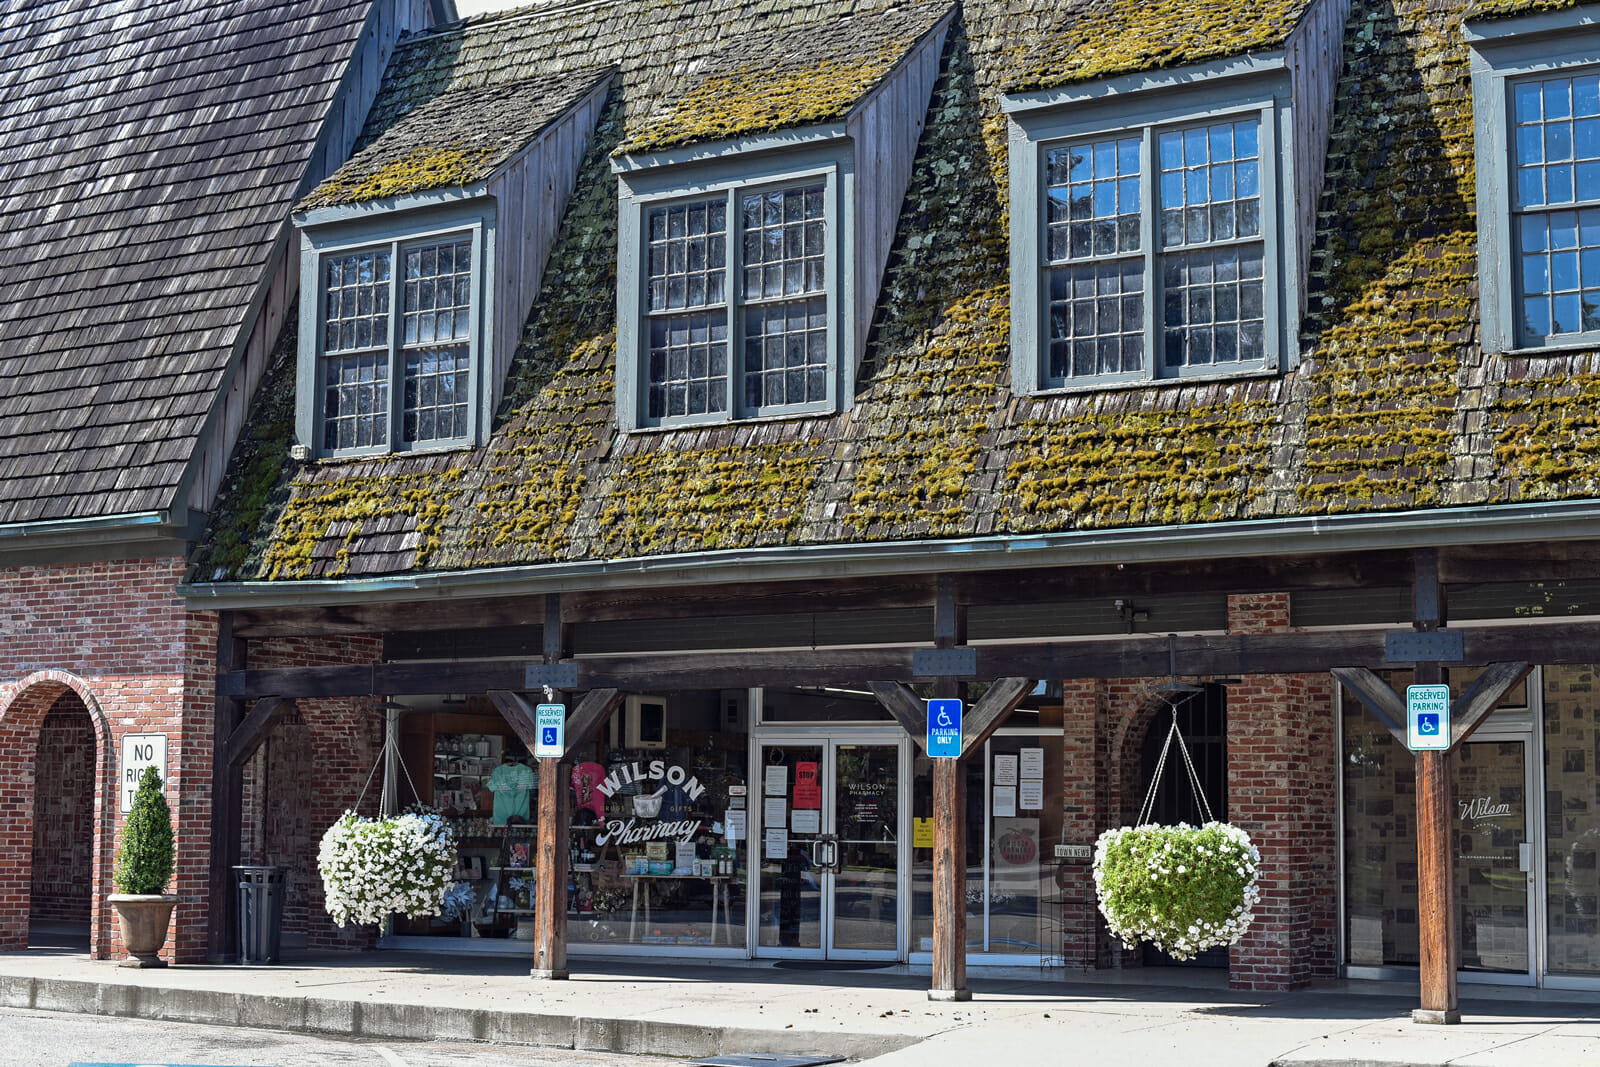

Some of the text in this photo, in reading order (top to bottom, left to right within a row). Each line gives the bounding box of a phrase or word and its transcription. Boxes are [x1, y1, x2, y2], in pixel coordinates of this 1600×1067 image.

[1411, 692, 1445, 700] RESERVED
[1412, 702, 1444, 710] PARKING
[538, 709, 562, 717] RESERVED
[539, 718, 561, 726] PARKING
[931, 728, 959, 736] PARKING
[135, 744, 153, 761] NO
[798, 771, 815, 779] STOP
[596, 760, 706, 801] WILSON
[1459, 796, 1511, 820] Wilson
[595, 819, 701, 846] Pharmacy
[1056, 847, 1090, 857] TOWN NEWS
